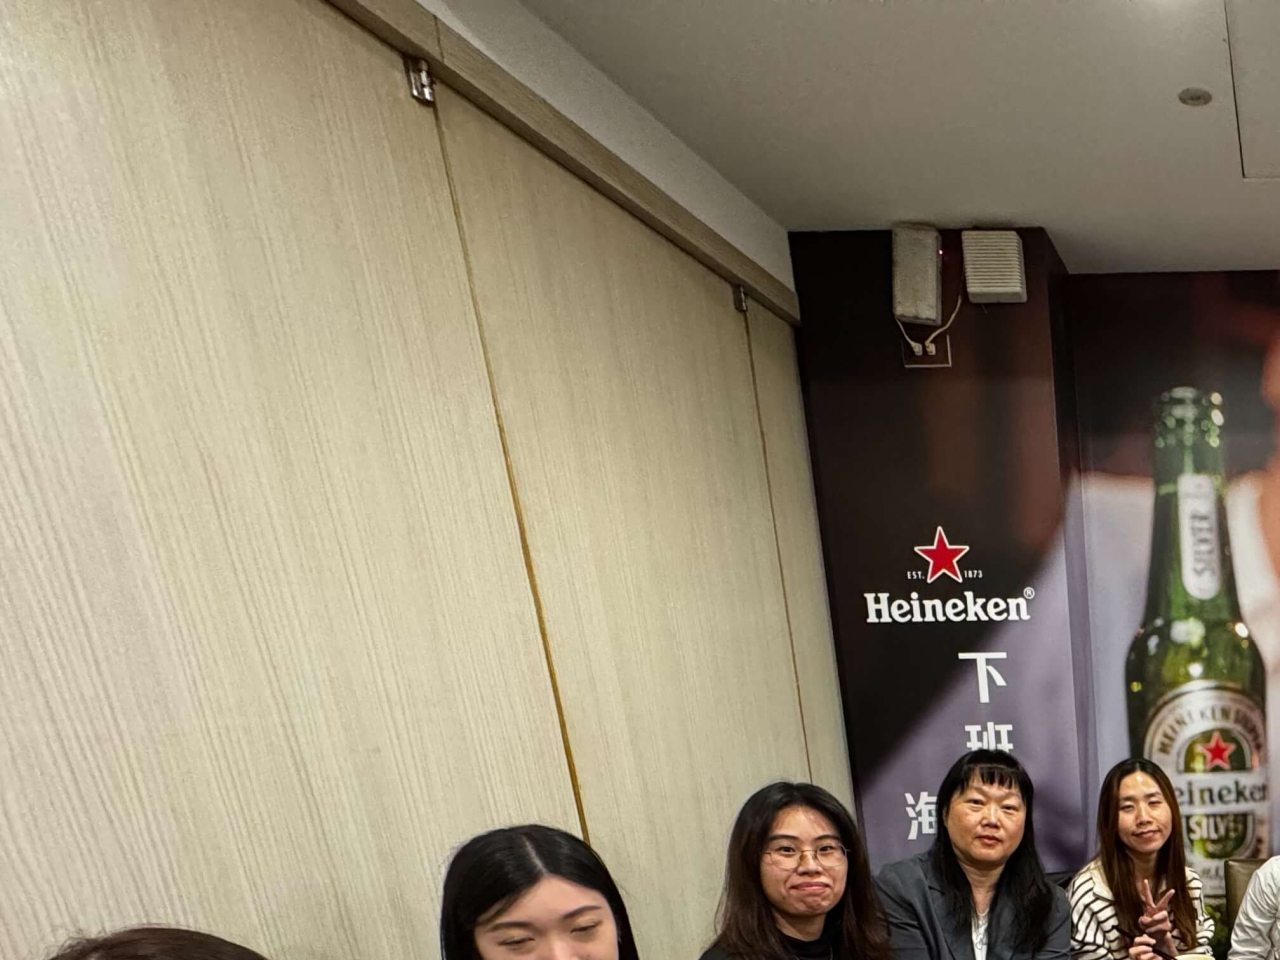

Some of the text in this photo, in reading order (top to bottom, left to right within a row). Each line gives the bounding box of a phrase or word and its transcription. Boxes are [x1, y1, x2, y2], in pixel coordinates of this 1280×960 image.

[907, 570, 983, 579] EST. 1873
[864, 591, 1031, 623] Heineken
